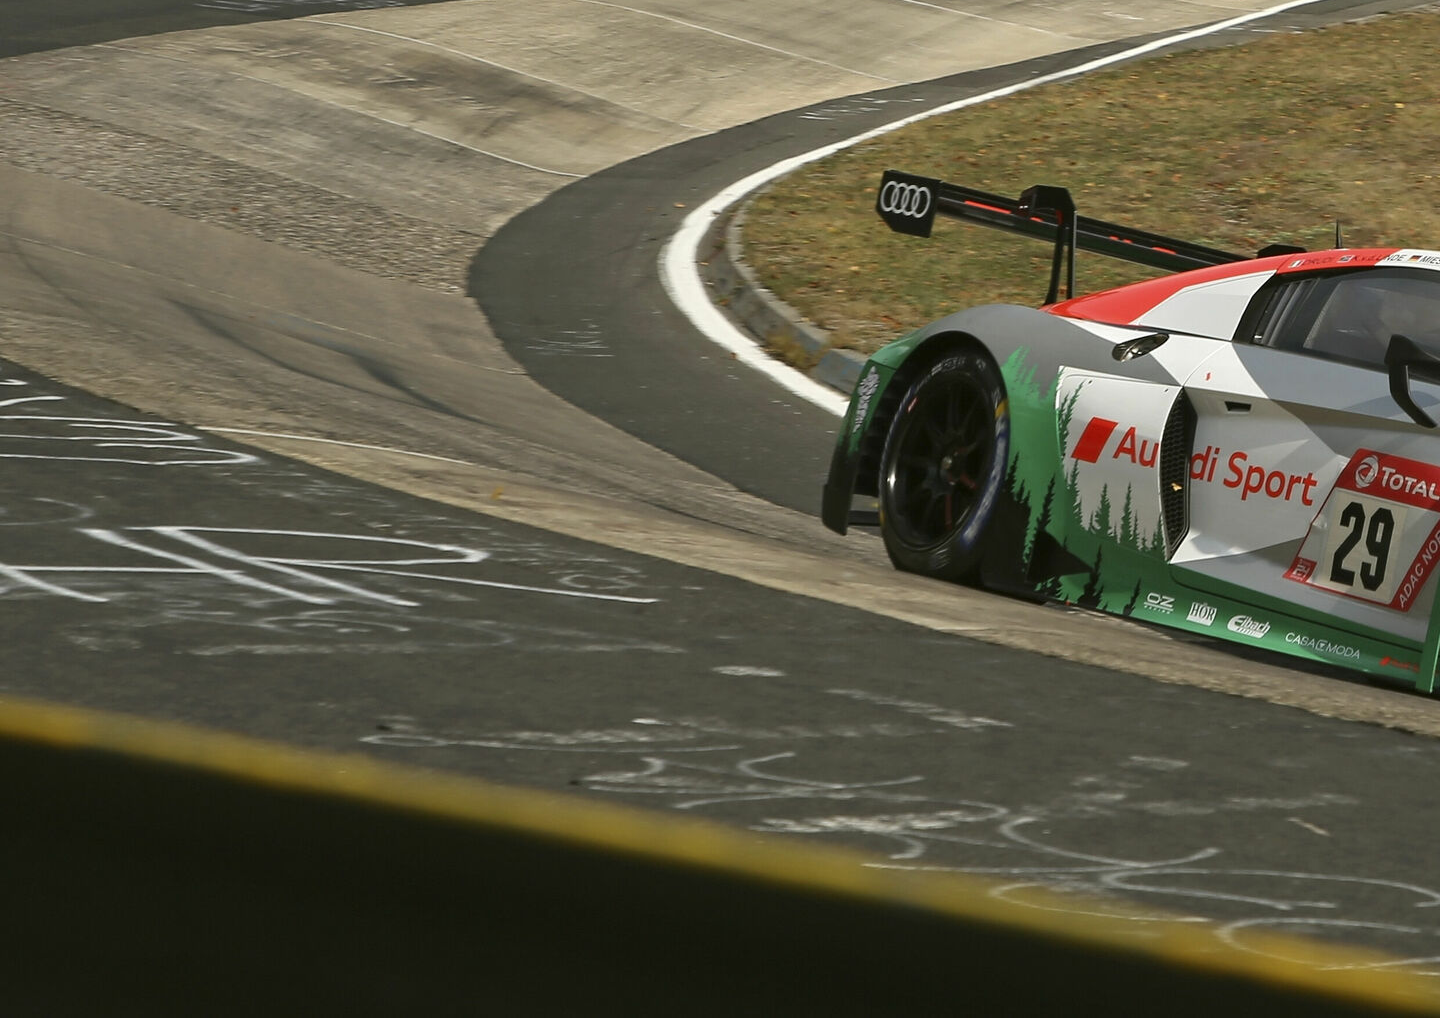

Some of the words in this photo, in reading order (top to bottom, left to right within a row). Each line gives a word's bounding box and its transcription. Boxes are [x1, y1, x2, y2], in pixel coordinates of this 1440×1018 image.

[1112, 426, 1220, 483] Audi
[1223, 451, 1318, 507] Sport
[1380, 466, 1440, 501] TOTAL
[1329, 501, 1395, 592] 29
[1146, 593, 1175, 608] OZ
[1400, 565, 1424, 608] ADAC
